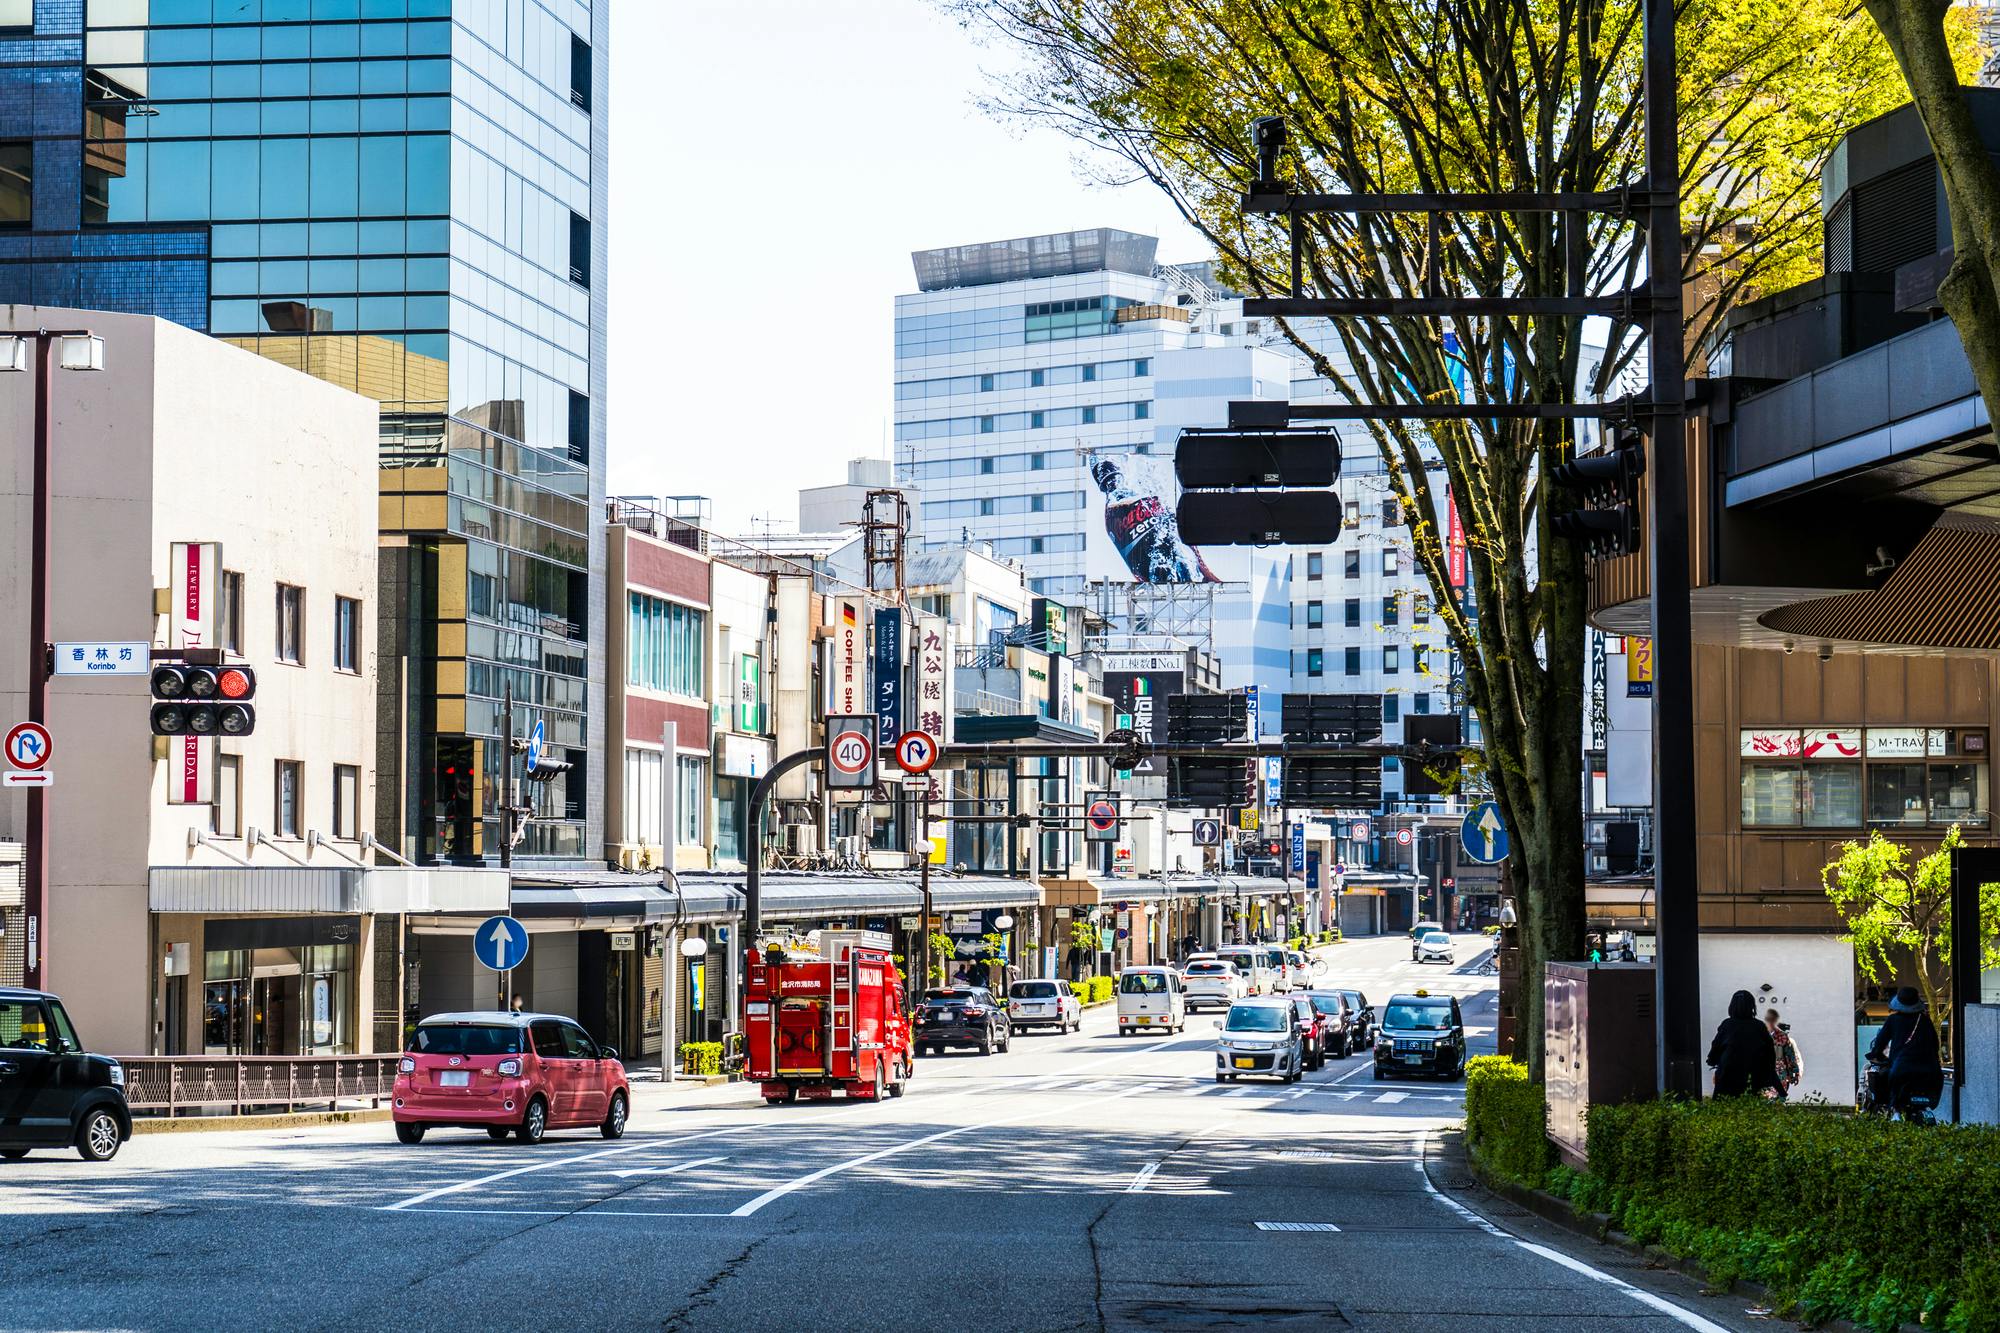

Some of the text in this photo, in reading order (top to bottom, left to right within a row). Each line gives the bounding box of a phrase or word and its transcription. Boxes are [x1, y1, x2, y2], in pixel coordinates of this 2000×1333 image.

[1129, 516, 1160, 540] zero
[189, 564, 198, 611] JEWELRY
[72, 647, 132, 661] 香林坊
[87, 661, 117, 671] Korinbo
[845, 629, 853, 683] COFFEE
[1158, 657, 1180, 670] No.1
[881, 680, 896, 745] ダンカン
[1133, 696, 1153, 771] 石友ホム
[186, 735, 197, 783] BRIDAL
[839, 743, 863, 762] 40
[1242, 811, 1257, 821] 24
[1294, 835, 1303, 868] カラオケ
[781, 980, 821, 989] 金沢市消防局
